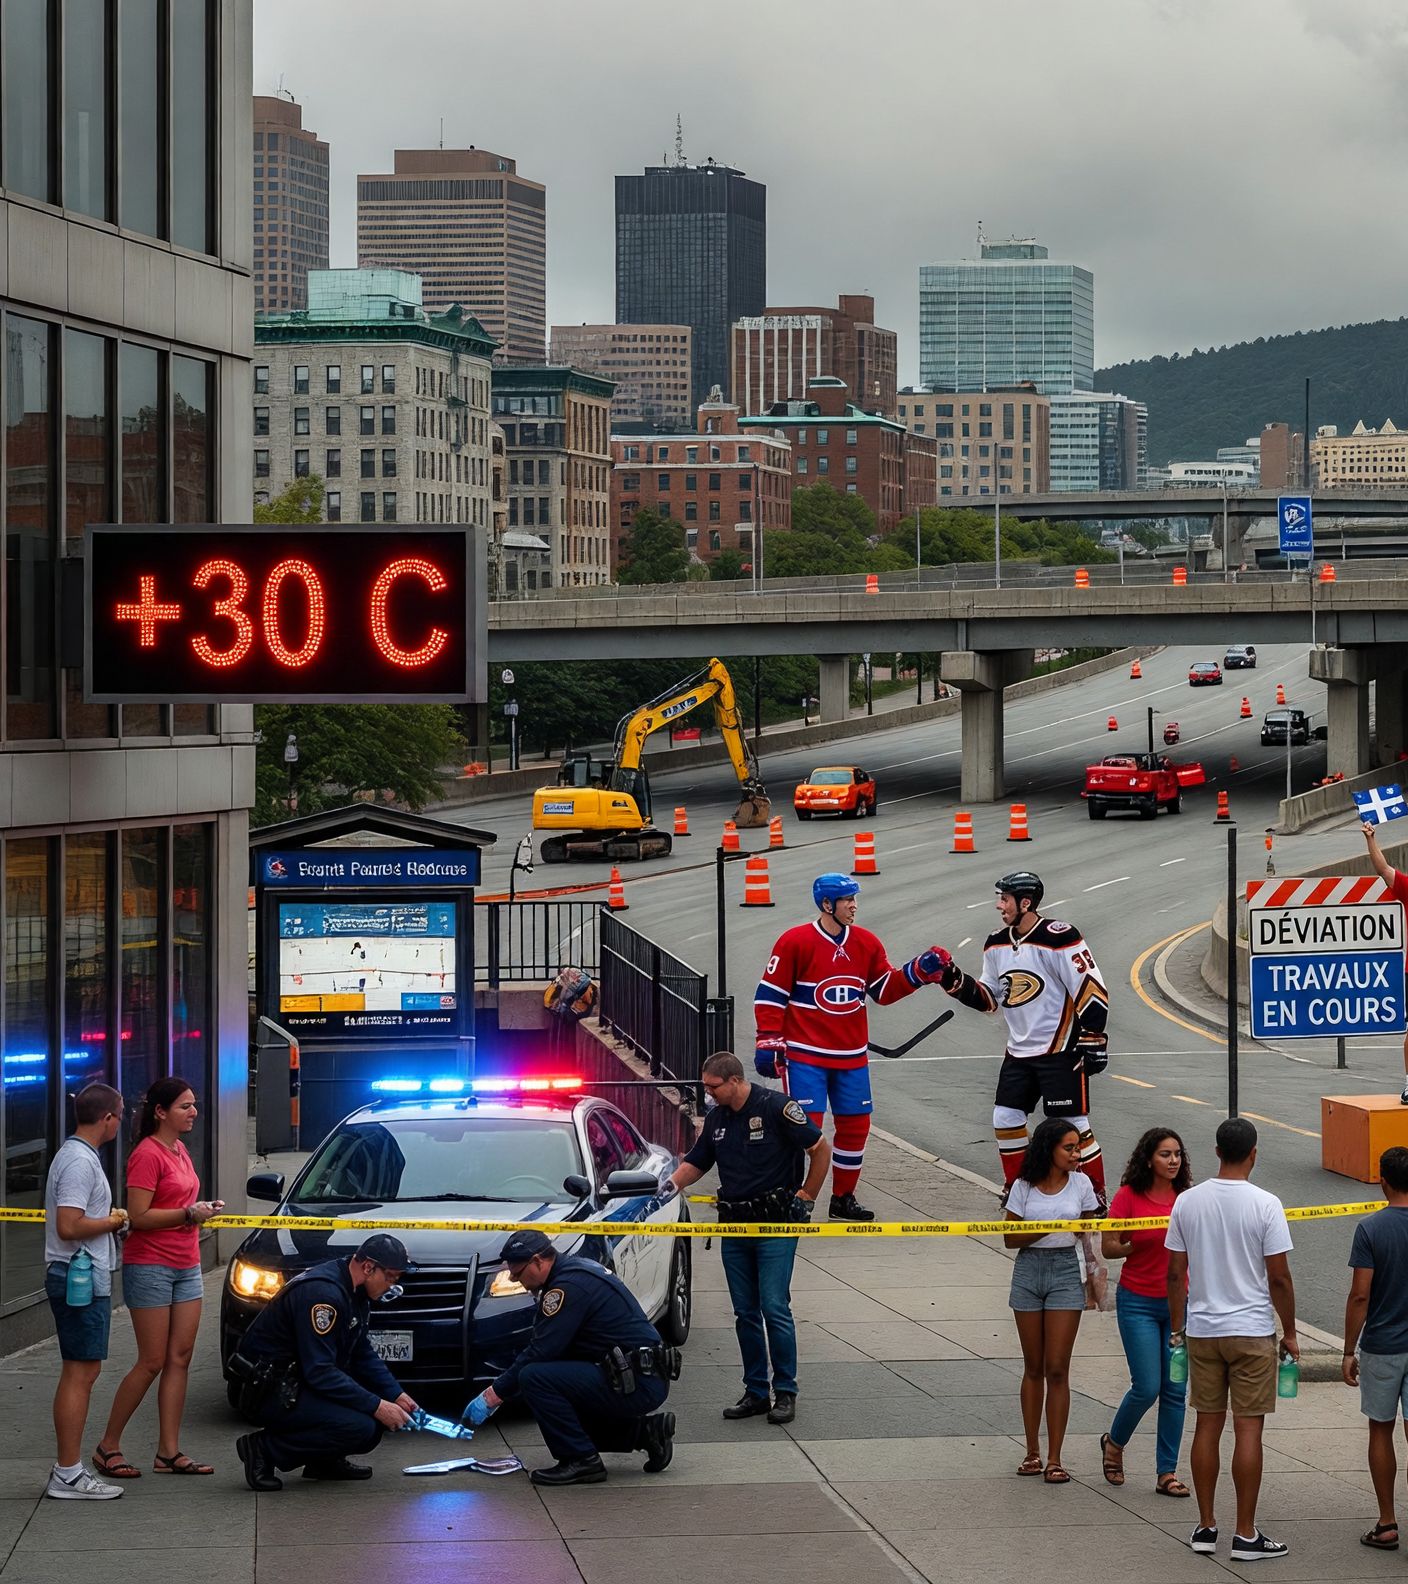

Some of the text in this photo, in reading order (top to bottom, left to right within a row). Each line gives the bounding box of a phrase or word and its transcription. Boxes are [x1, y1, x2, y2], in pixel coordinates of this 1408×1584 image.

[116, 558, 449, 667] +30 C
[1260, 911, 1395, 945] DÉVIATION
[1268, 961, 1390, 992] TRAVAUX
[1263, 996, 1397, 1027] EN COURS
